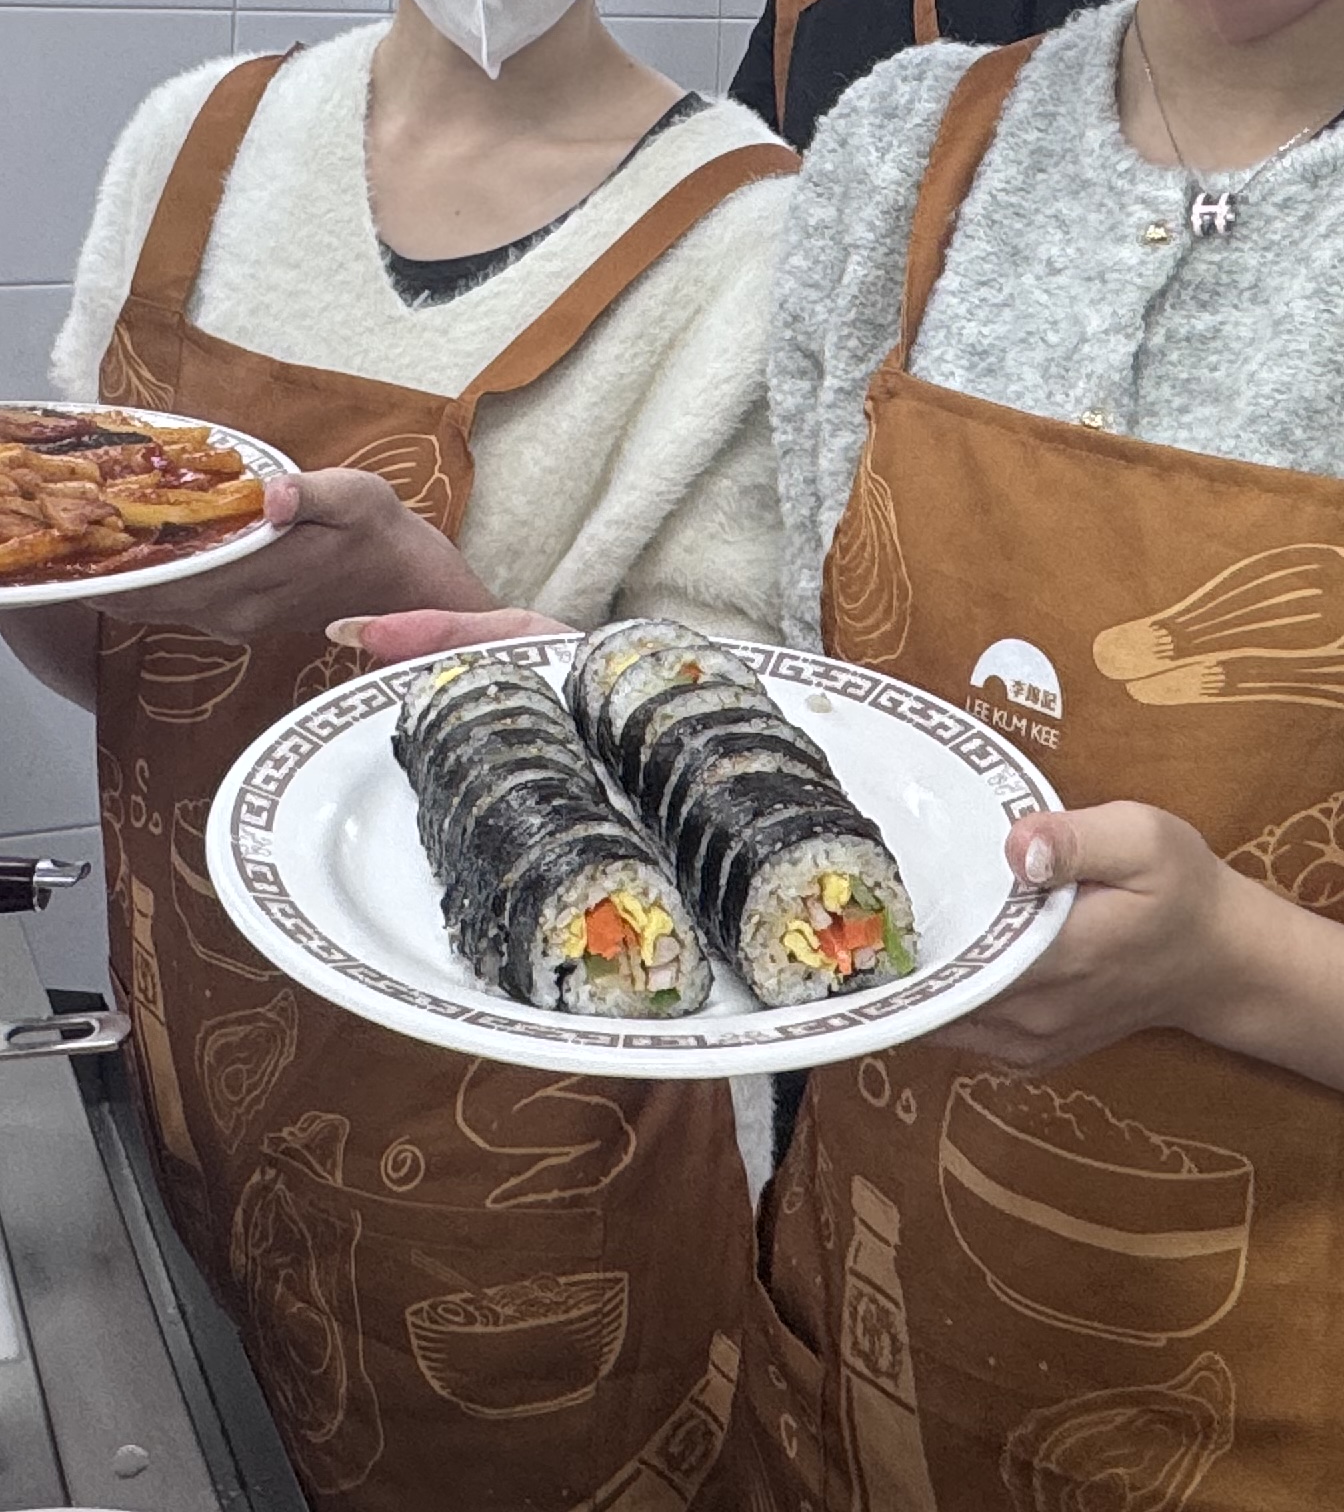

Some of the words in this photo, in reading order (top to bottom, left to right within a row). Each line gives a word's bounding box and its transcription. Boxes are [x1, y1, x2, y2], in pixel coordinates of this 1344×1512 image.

[965, 694, 990, 722] LEE
[993, 707, 1027, 737] KUM
[1031, 722, 1060, 749] KEE
